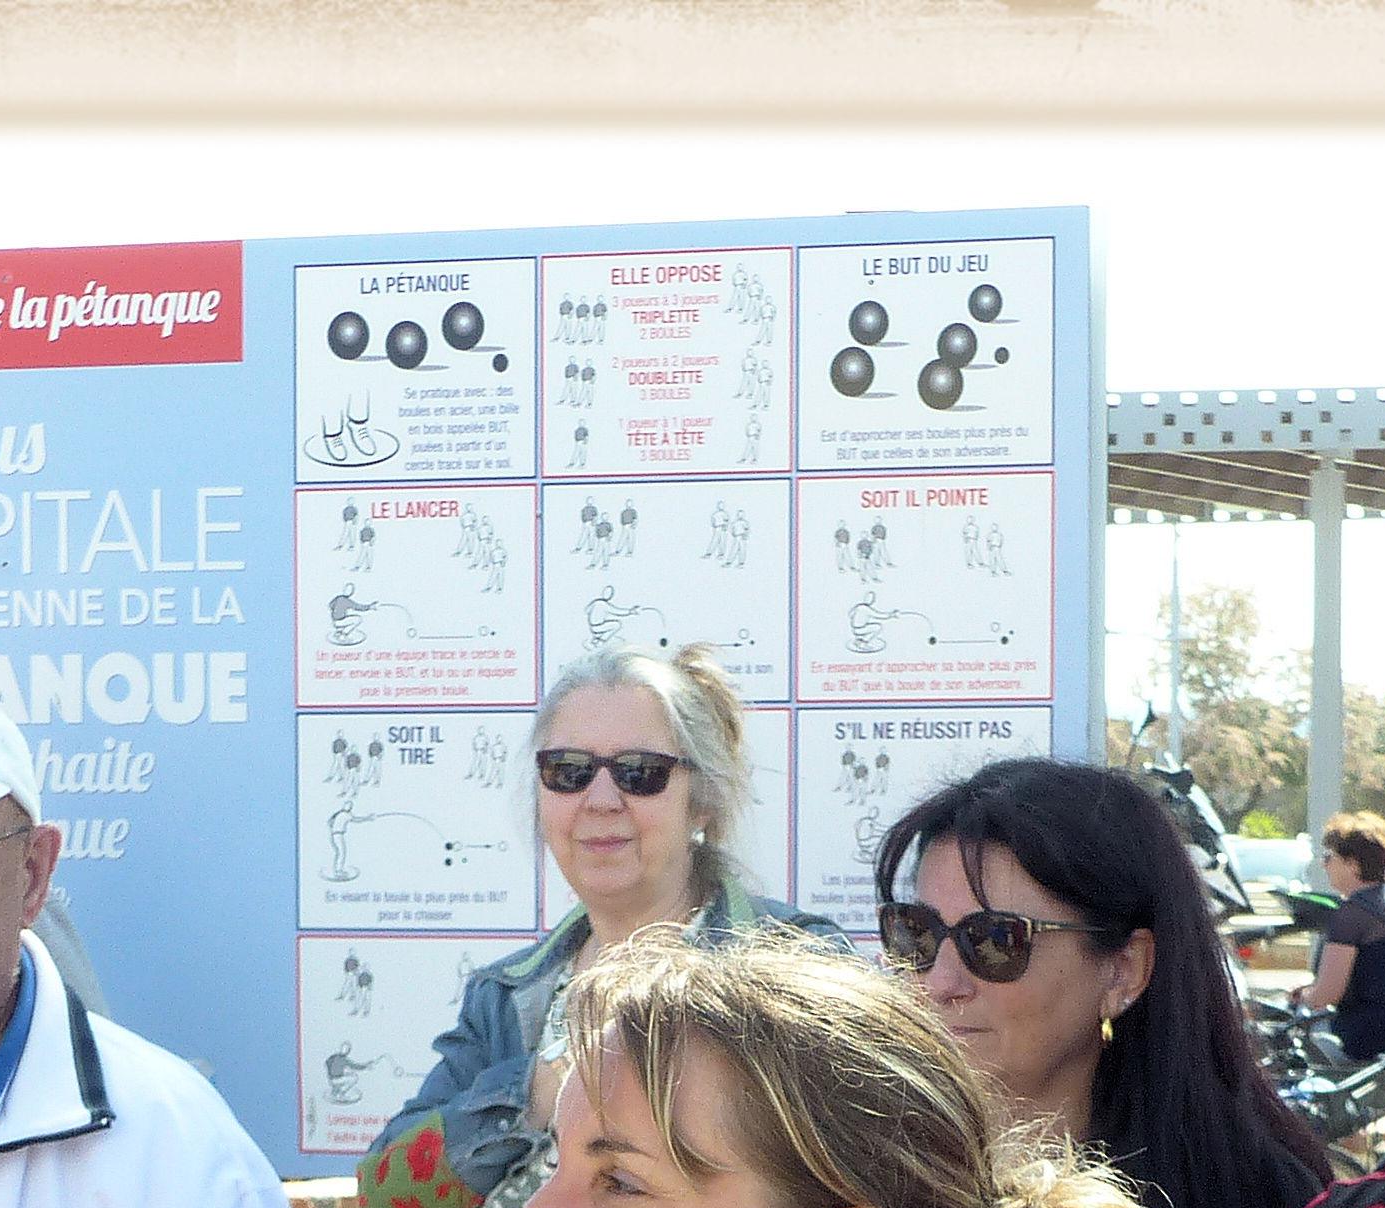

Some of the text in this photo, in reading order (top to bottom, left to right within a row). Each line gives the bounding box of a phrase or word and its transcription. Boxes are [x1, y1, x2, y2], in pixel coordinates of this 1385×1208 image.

[863, 254, 989, 276] LE BUT DU JEU
[360, 272, 470, 294] LA PÉTANQUE
[610, 264, 722, 286] ELLE OPPOSE
[9, 286, 47, 331] la
[47, 281, 221, 341] pétanque
[632, 309, 700, 325] TRIPLETTE
[640, 326, 691, 340] 2 BOULES
[628, 370, 703, 386] DOUBLETTE
[650, 388, 691, 400] BOULES
[627, 428, 705, 446] TÊTE TÊTE
[821, 426, 1029, 443] Est d'approcher ses boules plus près du
[649, 449, 691, 462] BOULES
[836, 447, 856, 460] BUT
[861, 448, 880, 461] que
[883, 446, 913, 458] celles
[916, 446, 930, 458] de
[933, 447, 952, 458] son
[861, 488, 988, 508] SOIT IL POINTE
[371, 500, 459, 519] LE LANCER
[119, 587, 179, 627] DE
[191, 586, 246, 625] LA
[388, 726, 444, 743] SOIT IL
[834, 717, 1012, 740] S'IL NE RÉUSSIT PAS
[400, 747, 435, 765] TIRE
